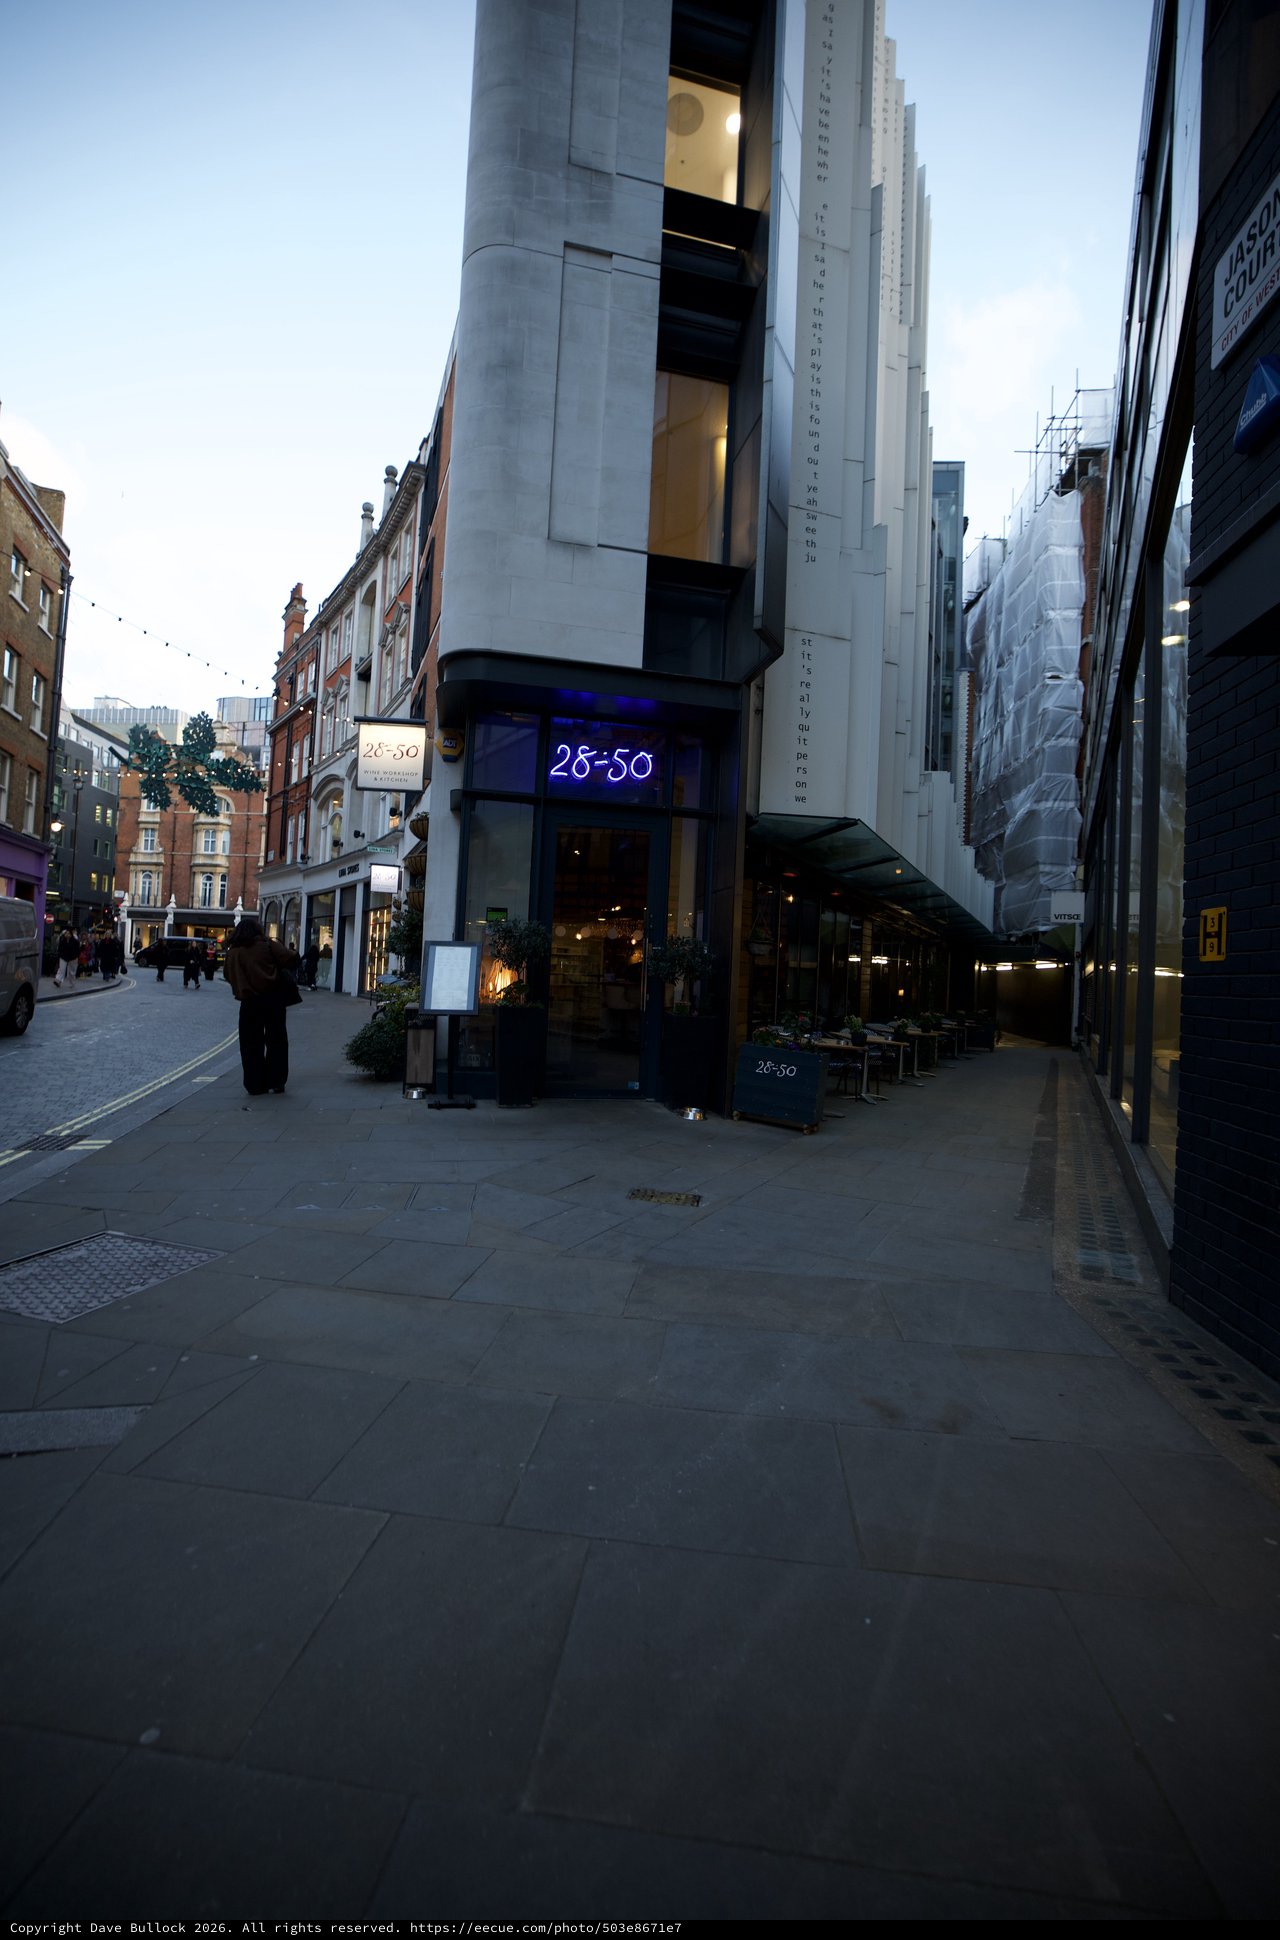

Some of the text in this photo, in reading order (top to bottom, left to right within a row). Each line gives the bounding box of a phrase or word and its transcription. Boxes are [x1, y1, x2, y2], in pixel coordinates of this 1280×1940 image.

[1221, 322, 1240, 351] CITY
[1241, 306, 1252, 325] OF
[1239, 392, 1268, 427] Chubb
[362, 743, 419, 760] 28-50
[443, 739, 457, 748] ADT
[550, 744, 653, 781] 28-50
[755, 1060, 798, 1078] 28-50
